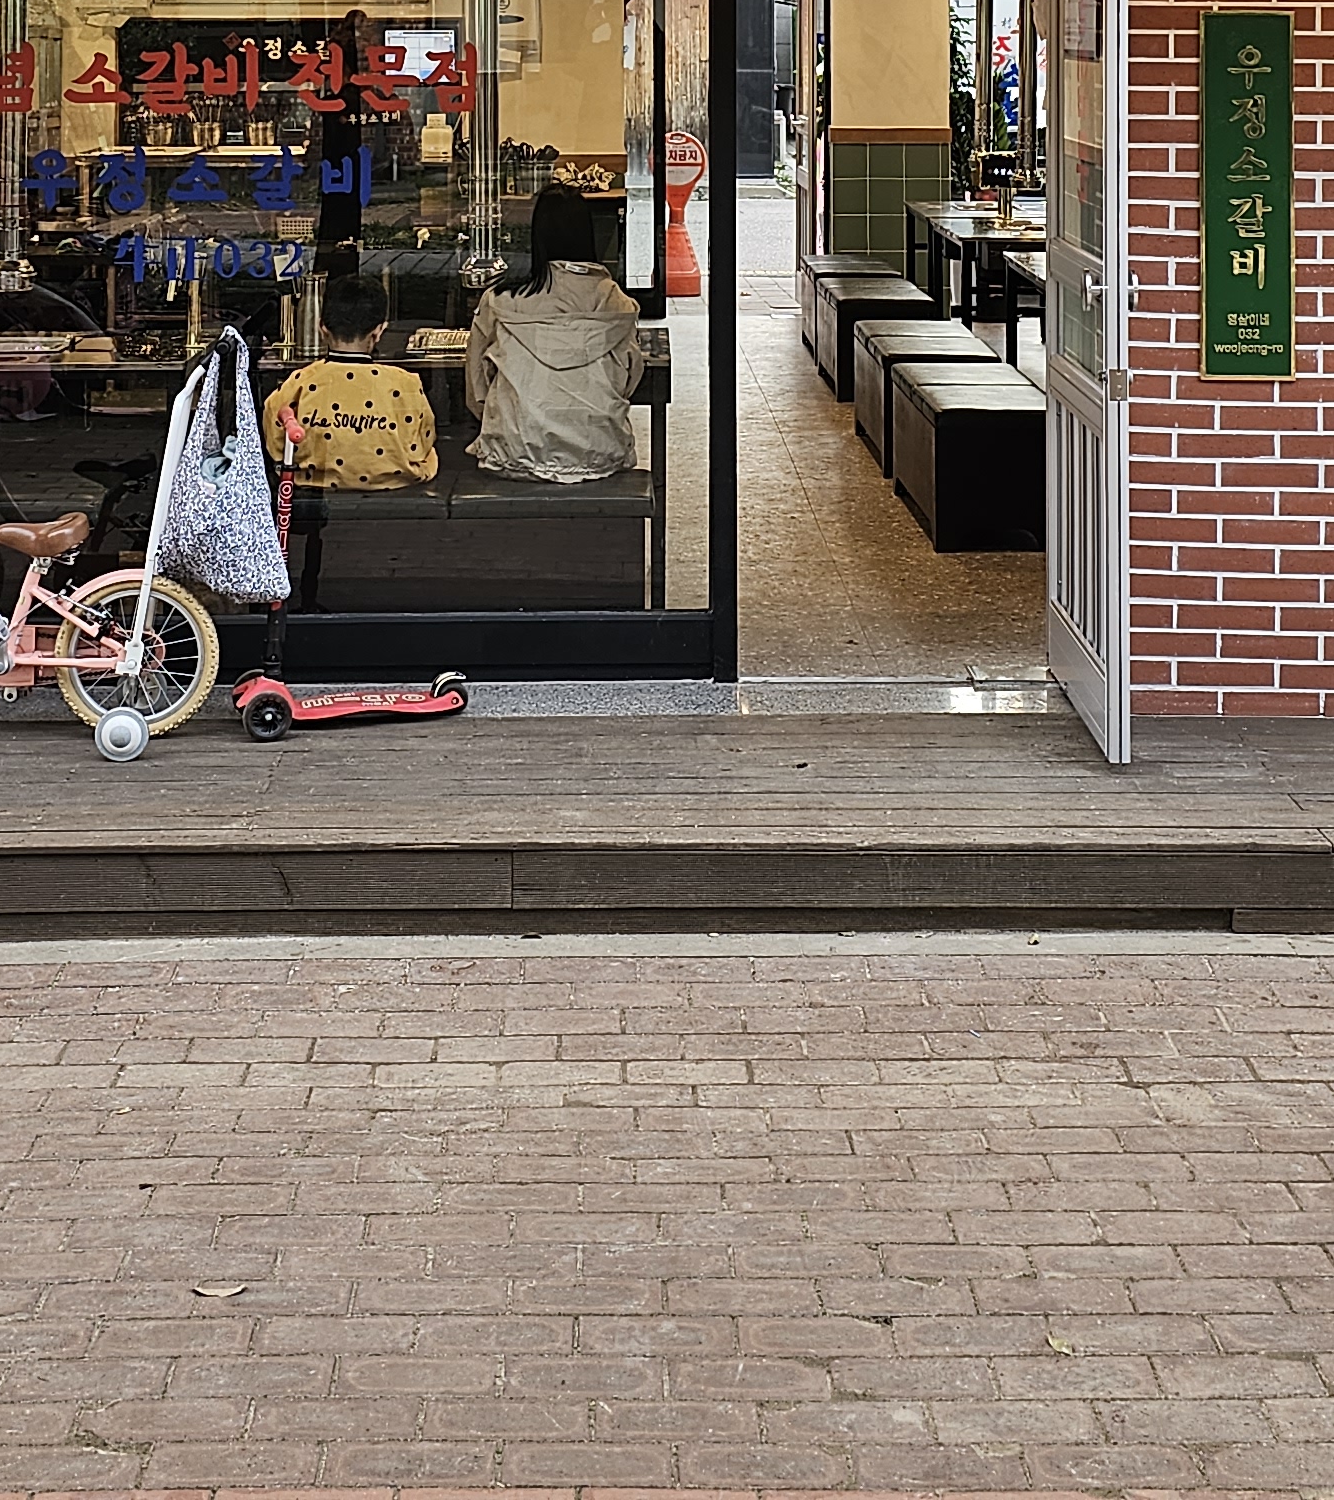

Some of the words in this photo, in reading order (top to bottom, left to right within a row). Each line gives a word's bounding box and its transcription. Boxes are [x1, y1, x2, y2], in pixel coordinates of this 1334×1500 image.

[63, 42, 260, 117] 소갈비
[287, 42, 478, 114] 전문점
[20, 144, 373, 215] 우정소갈비
[1226, 44, 1273, 291] 우정소갈비
[1213, 341, 1284, 356] woojeong-ro
[1237, 328, 1261, 340] 032
[309, 408, 331, 428] Le
